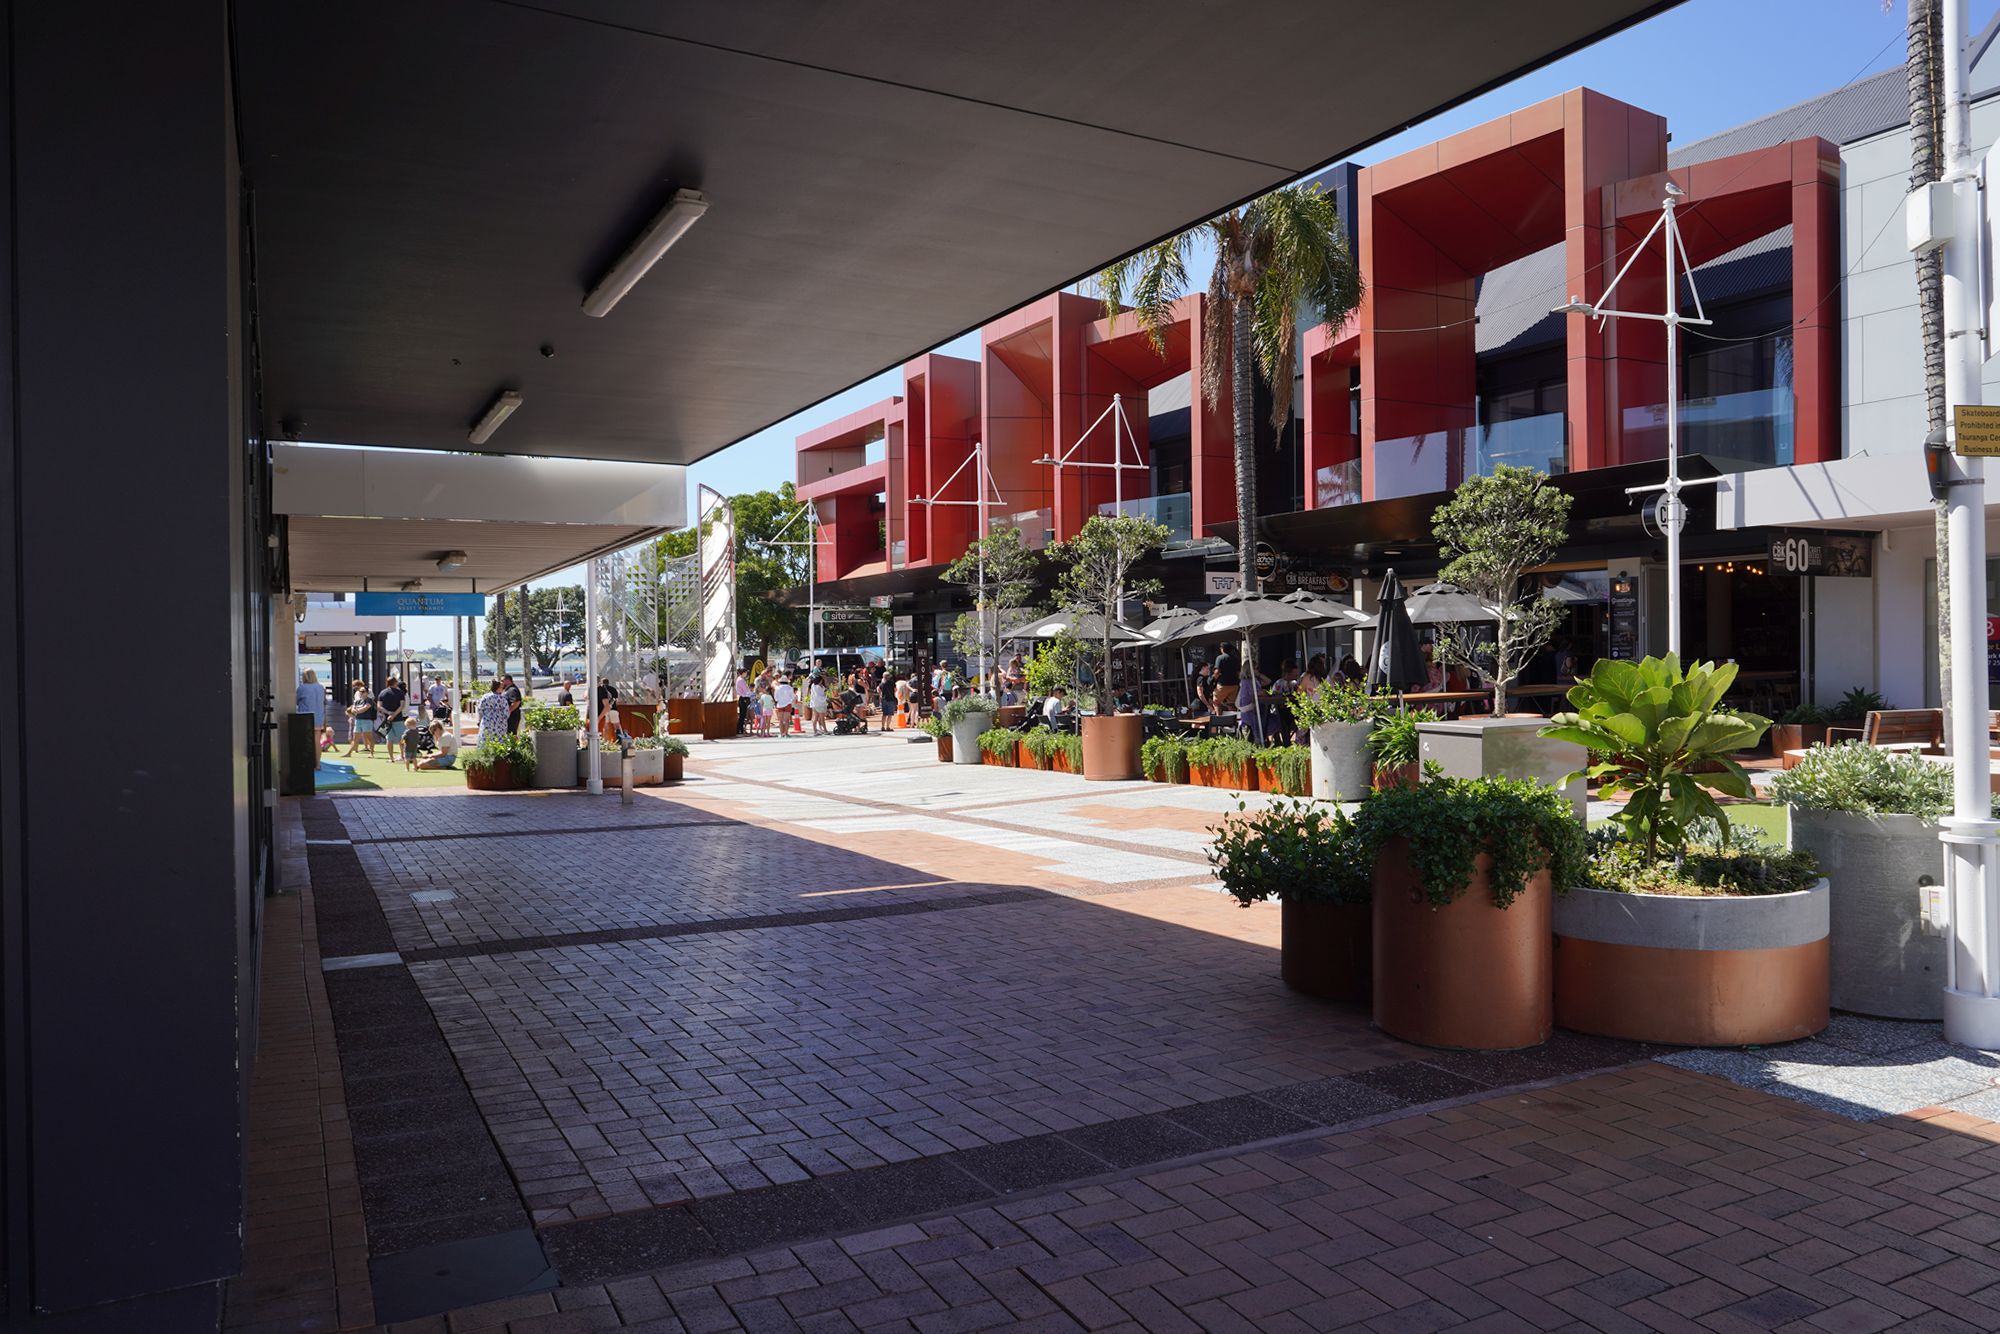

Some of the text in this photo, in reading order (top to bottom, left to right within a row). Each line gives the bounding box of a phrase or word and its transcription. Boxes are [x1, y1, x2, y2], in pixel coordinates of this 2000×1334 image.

[1960, 421, 1994, 429] Prohibited
[1958, 433, 1988, 442] Tauranga
[1963, 445, 1992, 453] Business
[1785, 538, 1809, 572] 60
[1298, 576, 1330, 586] BREAKFAST
[397, 598, 444, 606] QUANTUM
[831, 611, 847, 620] site
